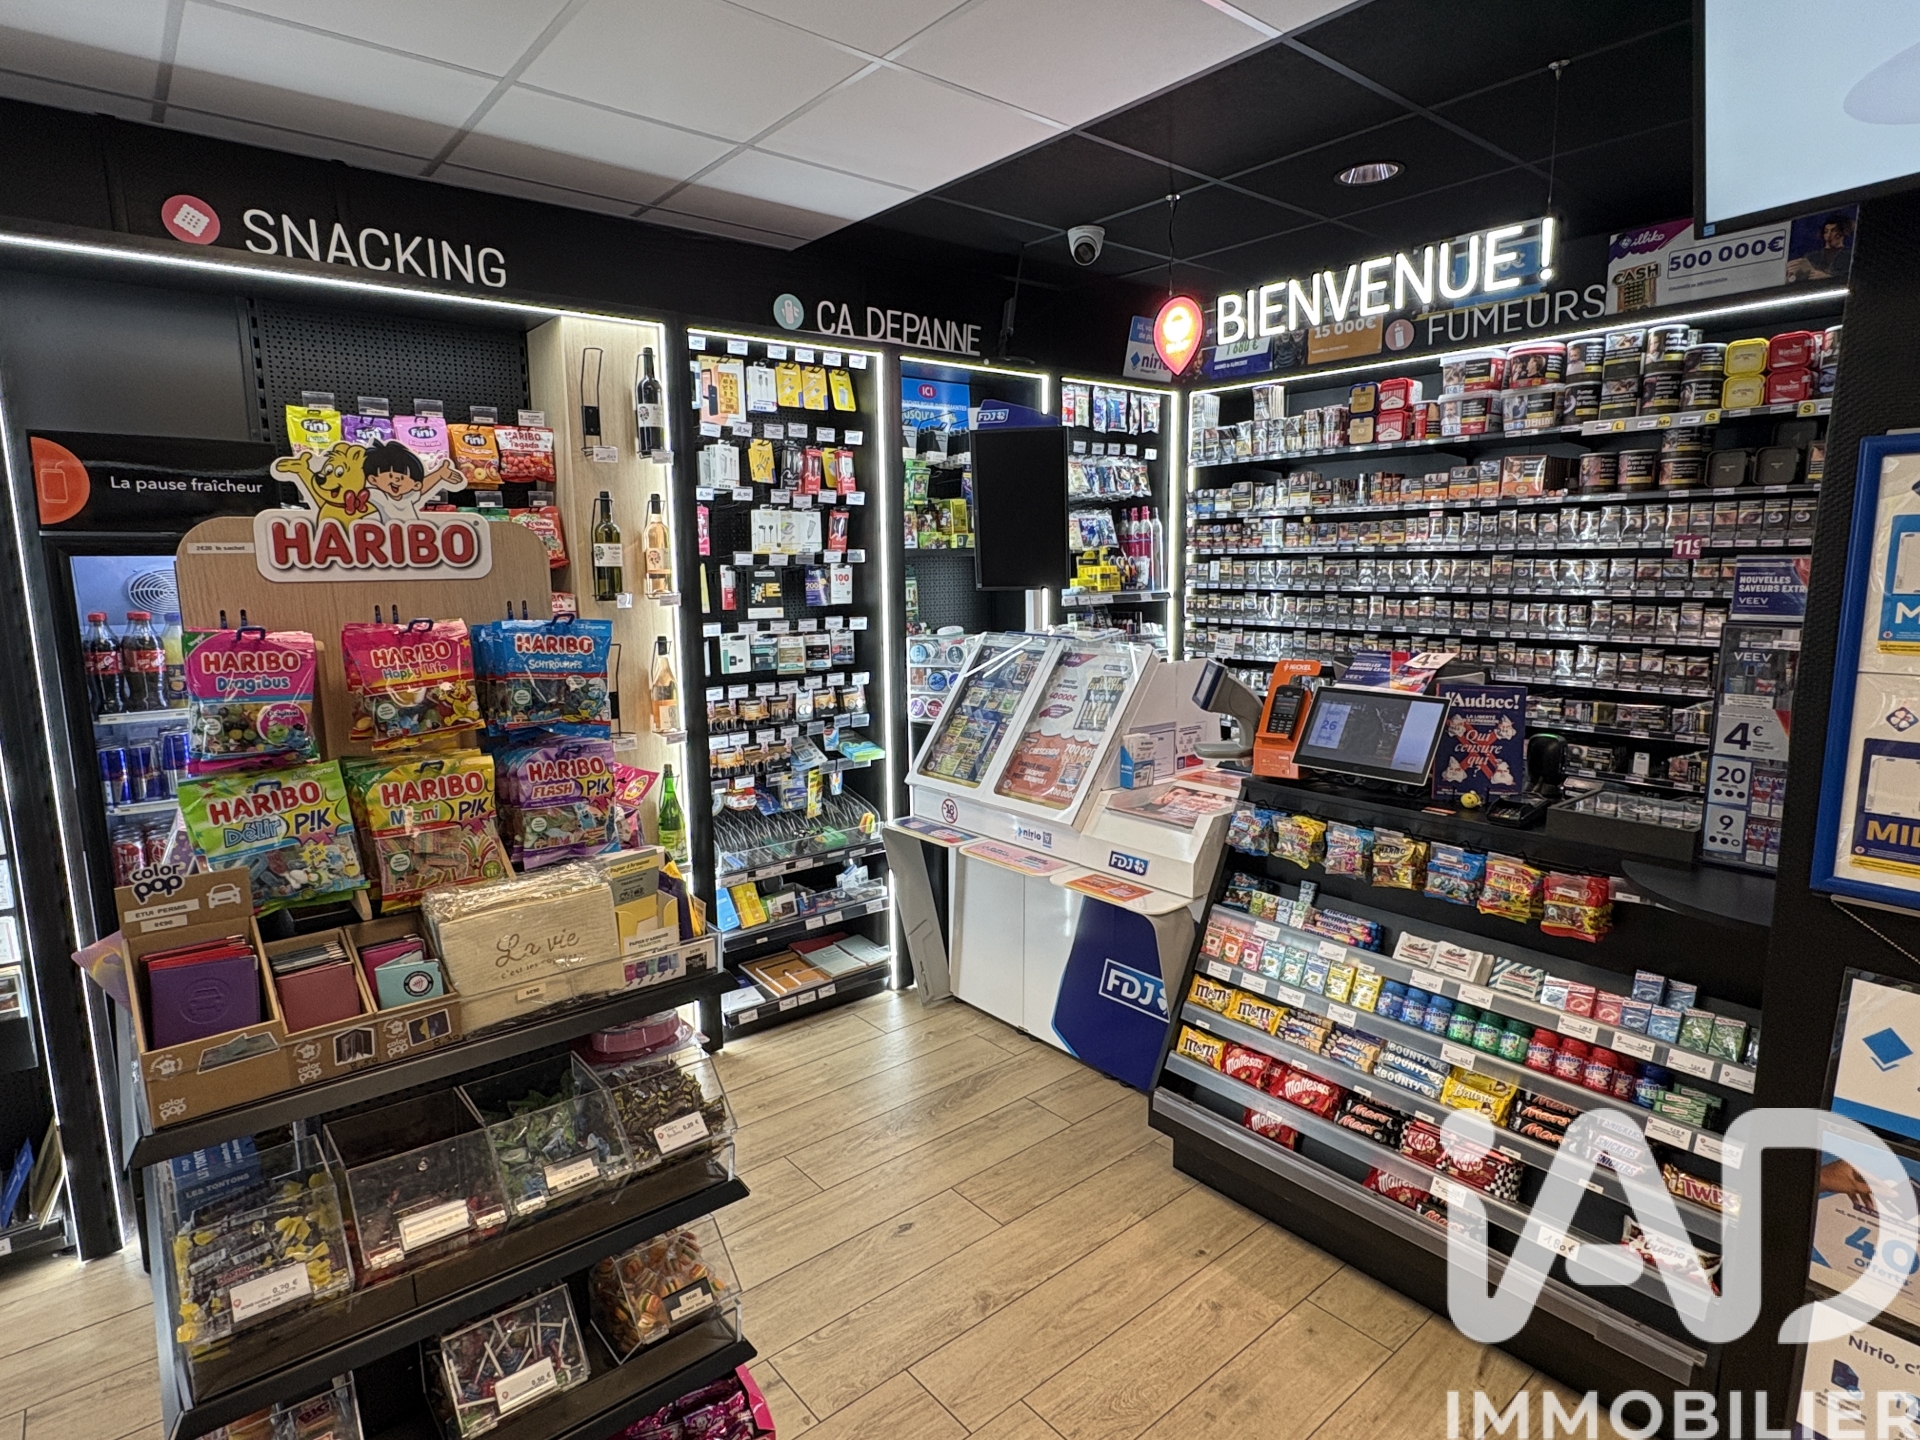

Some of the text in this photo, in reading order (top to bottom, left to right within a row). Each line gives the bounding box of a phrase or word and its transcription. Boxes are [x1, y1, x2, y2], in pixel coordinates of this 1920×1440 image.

[242, 207, 508, 288] SNACKING
[1669, 236, 1785, 272] 500 000€
[1612, 263, 1661, 286] CASH
[1427, 281, 1605, 345] FUMEURS
[816, 300, 982, 357] CA DEPANNE
[1313, 316, 1378, 339] 15 000€
[921, 386, 934, 397] ICI
[977, 411, 996, 422] FDJ
[1708, 412, 1716, 421] S
[1802, 405, 1812, 414] S
[110, 475, 264, 494] La pause fraîcheur
[271, 521, 476, 567] HARIBO
[834, 573, 850, 582] 100
[1739, 575, 1792, 585] NOUVELLES
[1738, 584, 1780, 593] SAVEURS
[1738, 596, 1769, 606] VEEV
[514, 633, 594, 655] HARIBO
[202, 651, 300, 675] HARIBO
[370, 639, 453, 670] HARIBO
[1412, 653, 1433, 667] 4
[1733, 651, 1773, 663] VEEV
[422, 661, 449, 675] Life
[216, 675, 290, 694] Dragibus
[1465, 729, 1492, 744] Qui
[1723, 722, 1752, 751] 4
[1454, 743, 1504, 755] censure
[527, 757, 607, 784] HARIBO
[1466, 753, 1491, 769] qui
[1471, 765, 1482, 778] ?
[1716, 765, 1747, 785] 20
[381, 771, 485, 807] HARIBO
[531, 782, 575, 800] FLASH
[208, 781, 322, 827] HARIBO
[1719, 814, 1735, 831] 9
[1023, 829, 1042, 841] nirio
[1111, 852, 1134, 870] FDJ
[131, 863, 181, 882] color
[133, 875, 184, 903] pop
[135, 904, 188, 919] ETUI PERMIS
[1320, 920, 1351, 934] mentos
[547, 928, 582, 953] vie
[1105, 969, 1154, 1008] FDJ
[386, 1036, 409, 1050] color
[387, 1043, 409, 1059] pop
[1225, 1052, 1265, 1074] Maltesers
[1386, 1052, 1427, 1075] BOUNTY
[1388, 1042, 1430, 1065] BOUNTY
[297, 1061, 322, 1075] color
[299, 1067, 323, 1084] pop
[1284, 1074, 1331, 1098] Maltesers
[1380, 1068, 1420, 1092] BOUNTY
[158, 1096, 186, 1111] color
[159, 1102, 188, 1121] pop
[1350, 1103, 1389, 1124] Mars
[1337, 1114, 1377, 1135] Mars
[1520, 1103, 1571, 1126] Mars
[1408, 1133, 1438, 1150] KitKat
[1597, 1135, 1639, 1160] SNICKERS
[1454, 1154, 1484, 1170] KitKat
[1596, 1152, 1637, 1176] SNICKERS
[185, 1172, 250, 1200] LES TONTONS
[1681, 1176, 1734, 1207] Twix
[1643, 1233, 1686, 1261] bueno
[1844, 1225, 1920, 1276] 40
[1847, 1333, 1900, 1370] Nirio,
[299, 1400, 332, 1426] BIG
